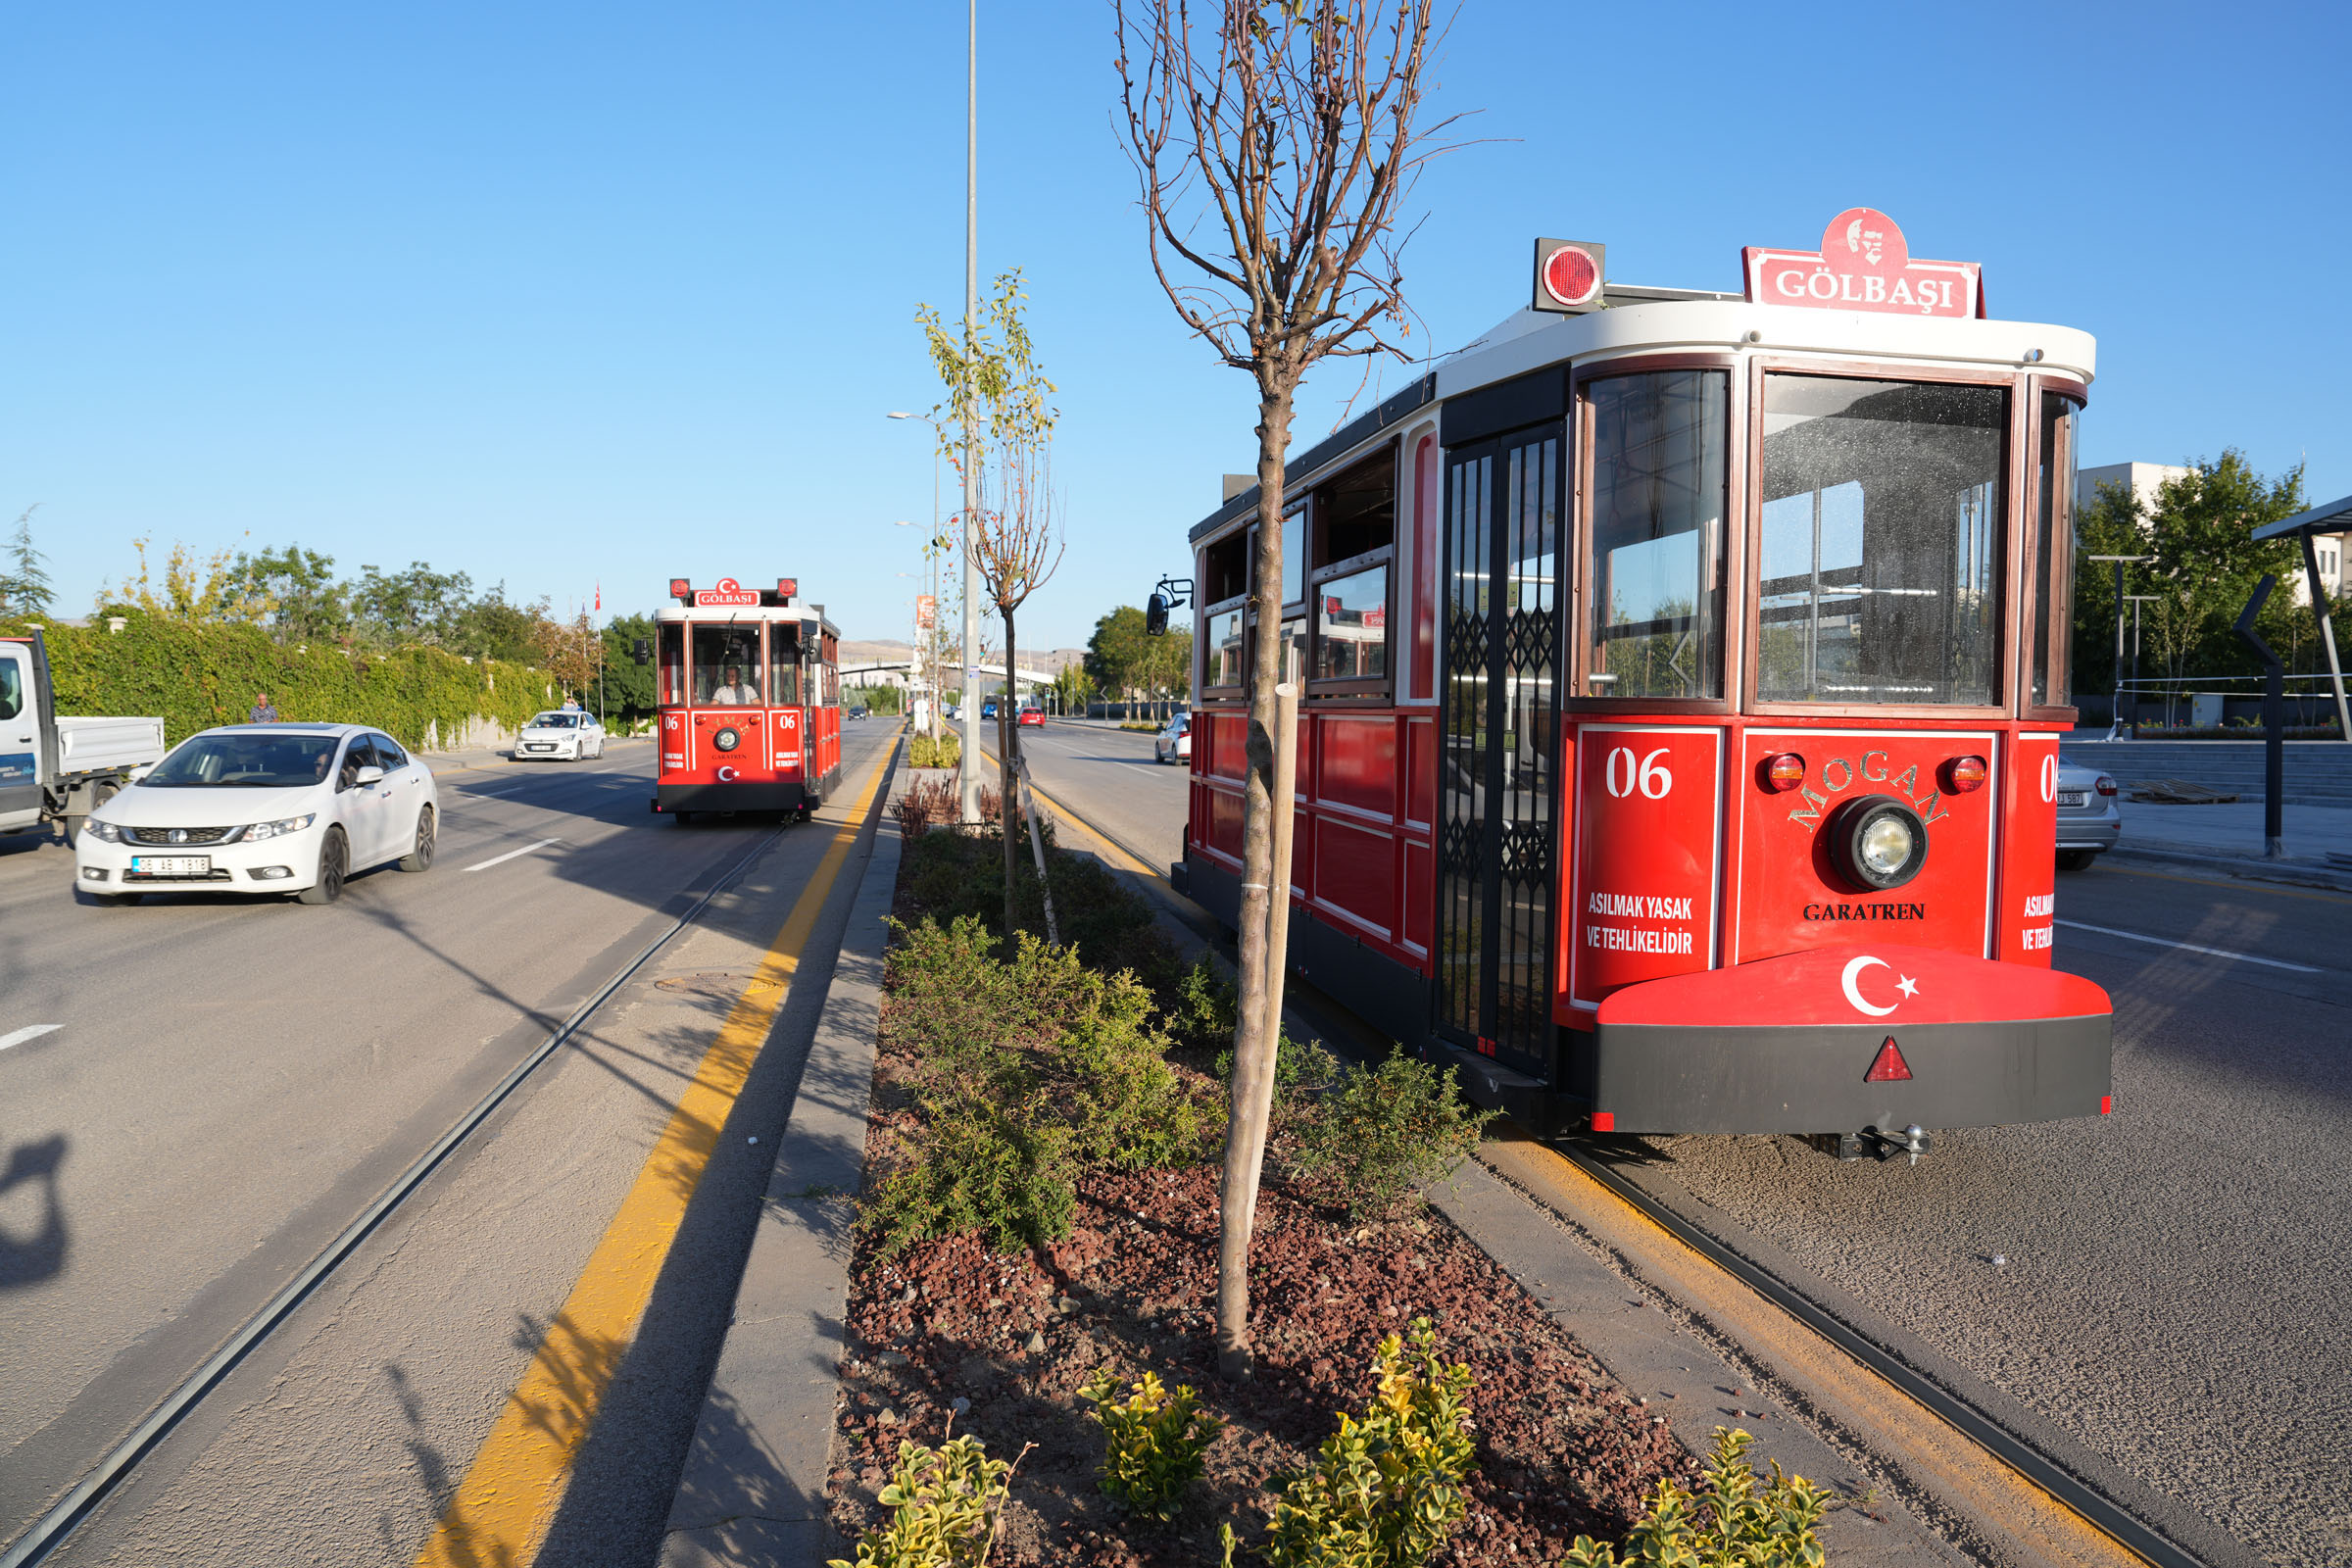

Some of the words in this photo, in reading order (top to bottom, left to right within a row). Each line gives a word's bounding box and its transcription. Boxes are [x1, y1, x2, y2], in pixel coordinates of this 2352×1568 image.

[1776, 266, 1953, 314] GÖLBAŞI
[701, 594, 752, 605] GÖLBAŞI
[665, 715, 678, 730] 06
[779, 714, 796, 729] 06
[1606, 747, 1672, 800] 06
[2040, 754, 2059, 803] 0
[1788, 750, 1949, 833] MOGAN
[1589, 892, 1644, 918] ASILMAK
[1646, 896, 1692, 920] YASAK
[1803, 903, 1926, 921] GARATREN
[1588, 925, 1600, 948] VE
[1601, 925, 1692, 955] TEHLİKELİDİR
[2022, 929, 2034, 951] VE
